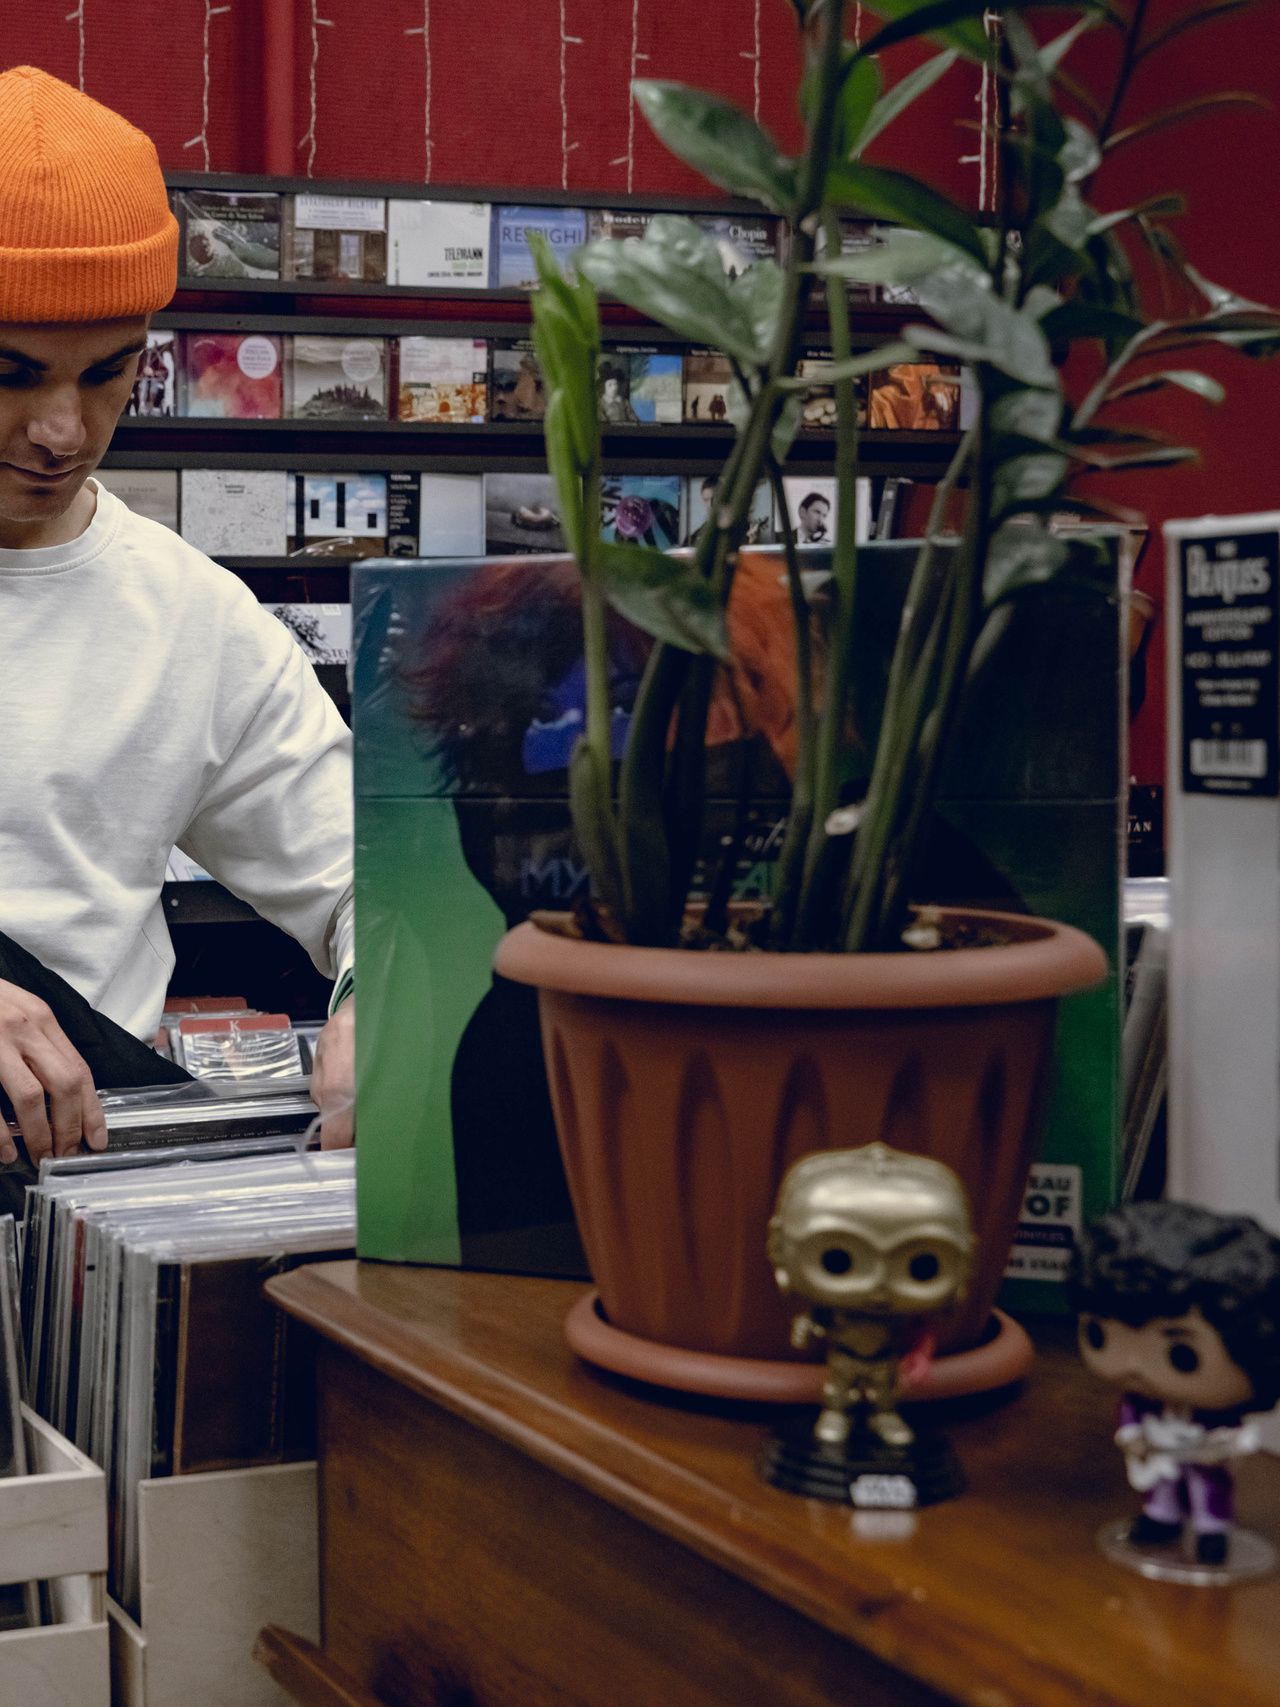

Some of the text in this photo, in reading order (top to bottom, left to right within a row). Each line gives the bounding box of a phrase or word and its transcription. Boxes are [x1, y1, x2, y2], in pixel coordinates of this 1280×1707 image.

[729, 225, 768, 242] Chopin
[444, 247, 483, 261] TELEMANN
[229, 1020, 242, 1032] K
